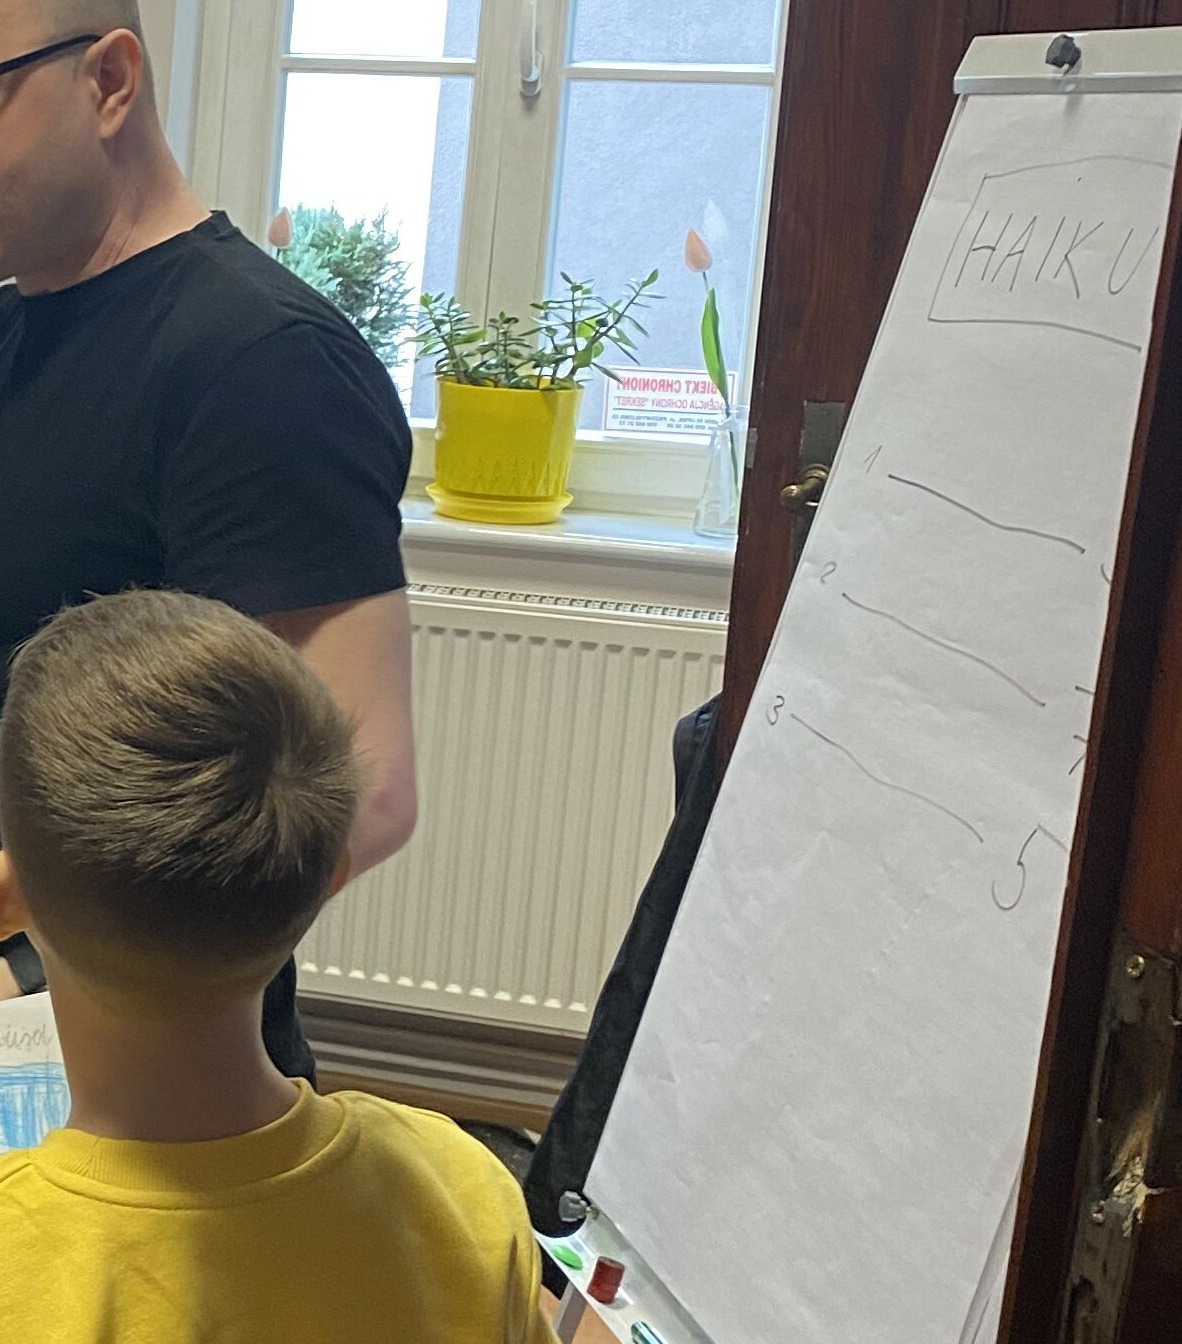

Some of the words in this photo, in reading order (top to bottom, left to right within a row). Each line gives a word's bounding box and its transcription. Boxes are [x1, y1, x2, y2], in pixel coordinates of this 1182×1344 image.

[955, 211, 1159, 298] HAIKU
[864, 445, 883, 474] 1
[820, 560, 837, 585] 2
[766, 695, 785, 726] 3
